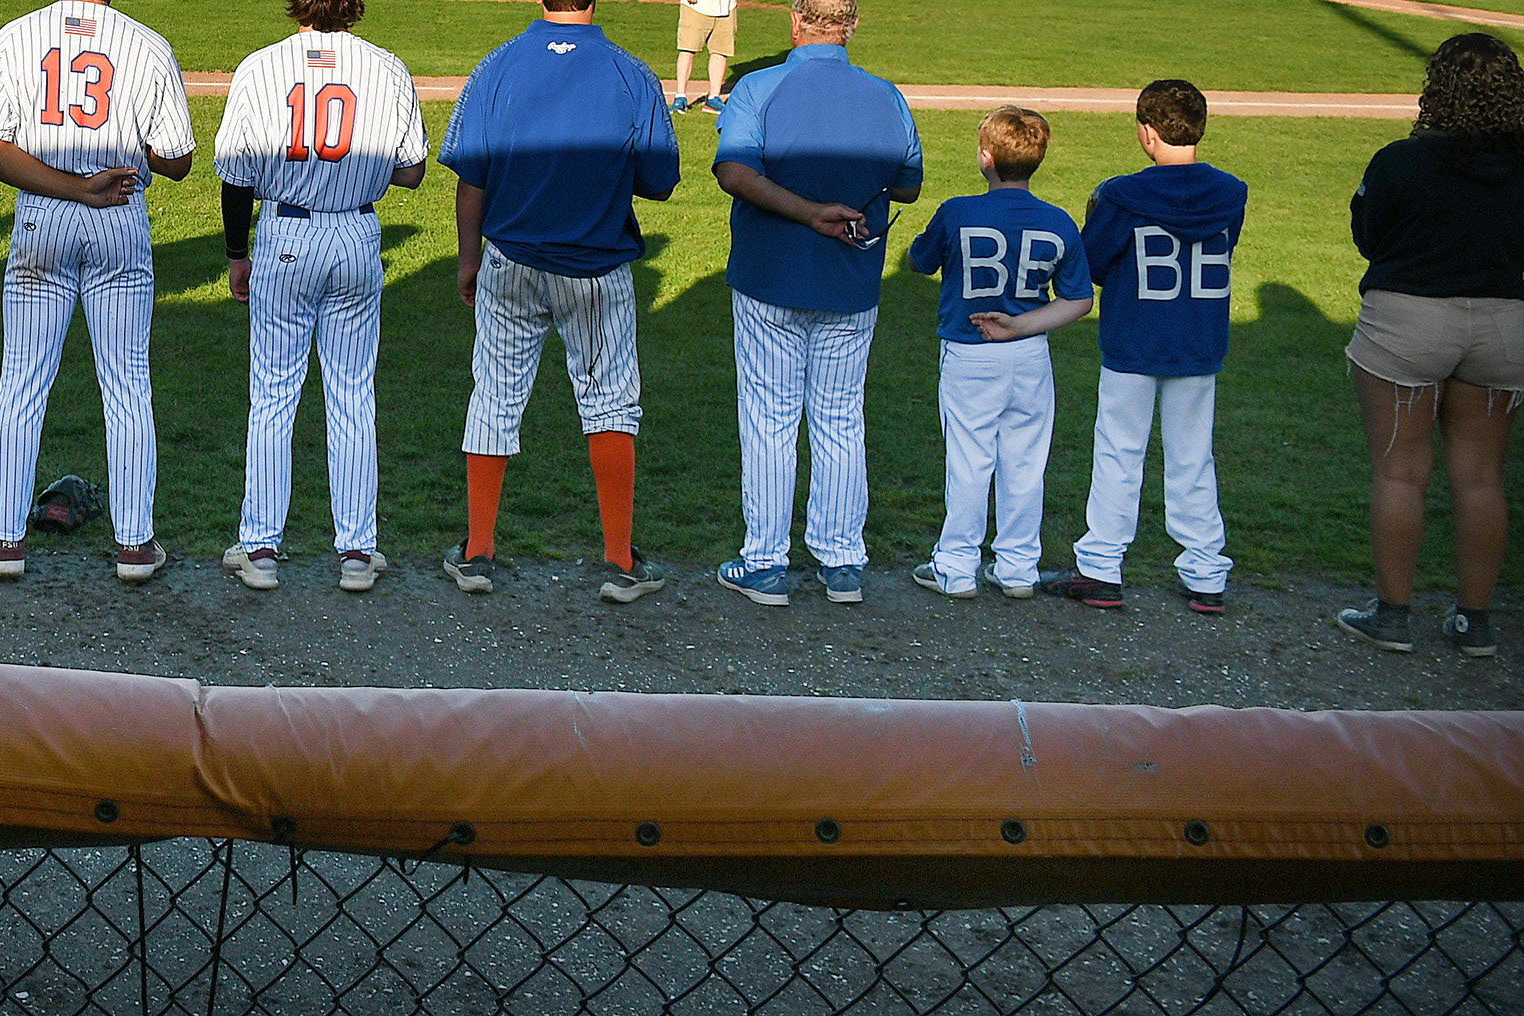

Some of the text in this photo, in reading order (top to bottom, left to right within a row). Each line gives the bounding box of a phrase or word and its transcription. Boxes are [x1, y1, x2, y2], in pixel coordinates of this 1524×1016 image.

[40, 46, 116, 131] 13
[286, 82, 358, 163] 10
[959, 226, 1066, 300] BB
